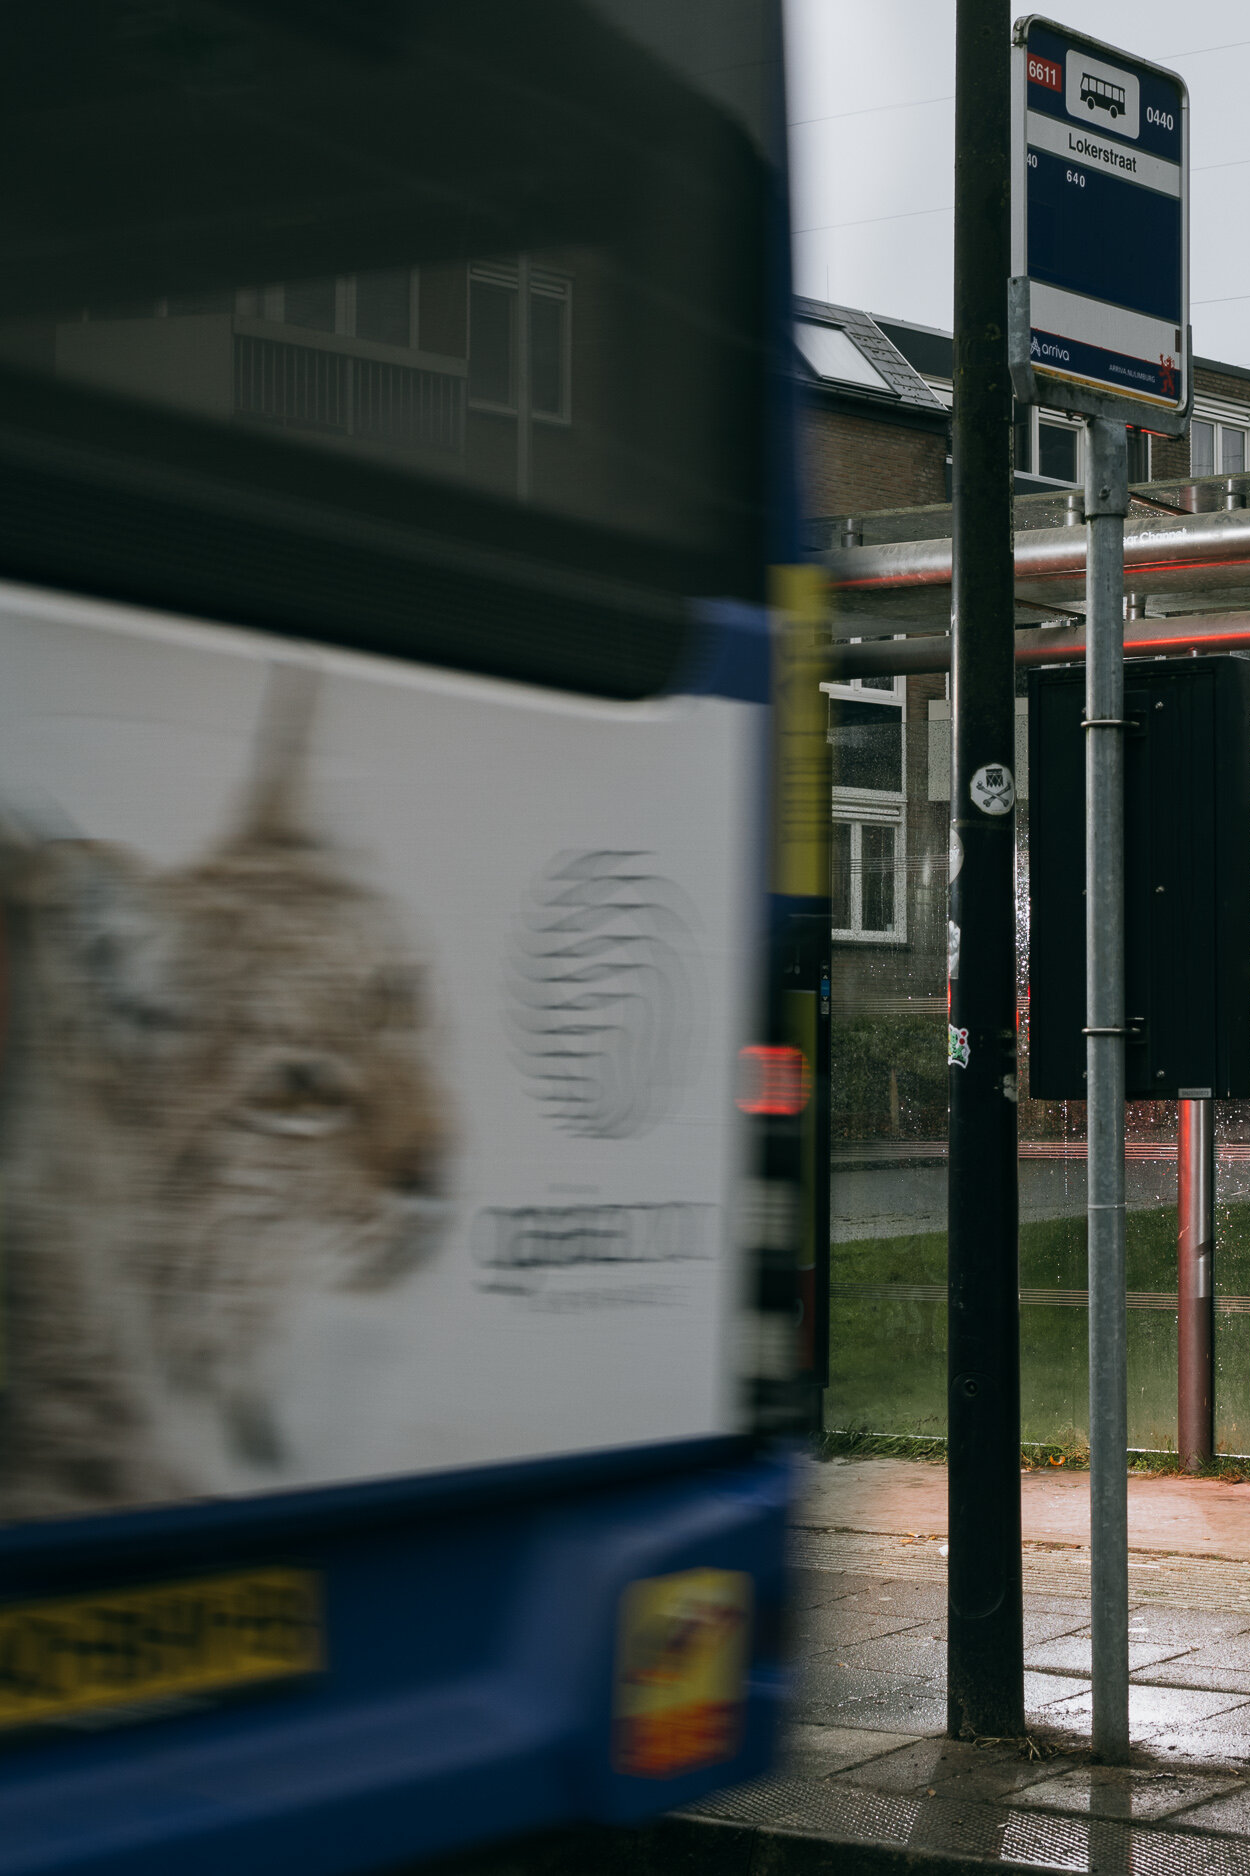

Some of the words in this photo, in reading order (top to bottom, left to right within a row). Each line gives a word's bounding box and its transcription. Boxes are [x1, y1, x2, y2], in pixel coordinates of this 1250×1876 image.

[1029, 60, 1056, 85] 6611
[1146, 106, 1174, 131] 0440
[1027, 153, 1038, 168] 40
[1068, 132, 1137, 173] Lokerstraat
[1066, 170, 1086, 188] 640
[1041, 343, 1070, 361] arriva
